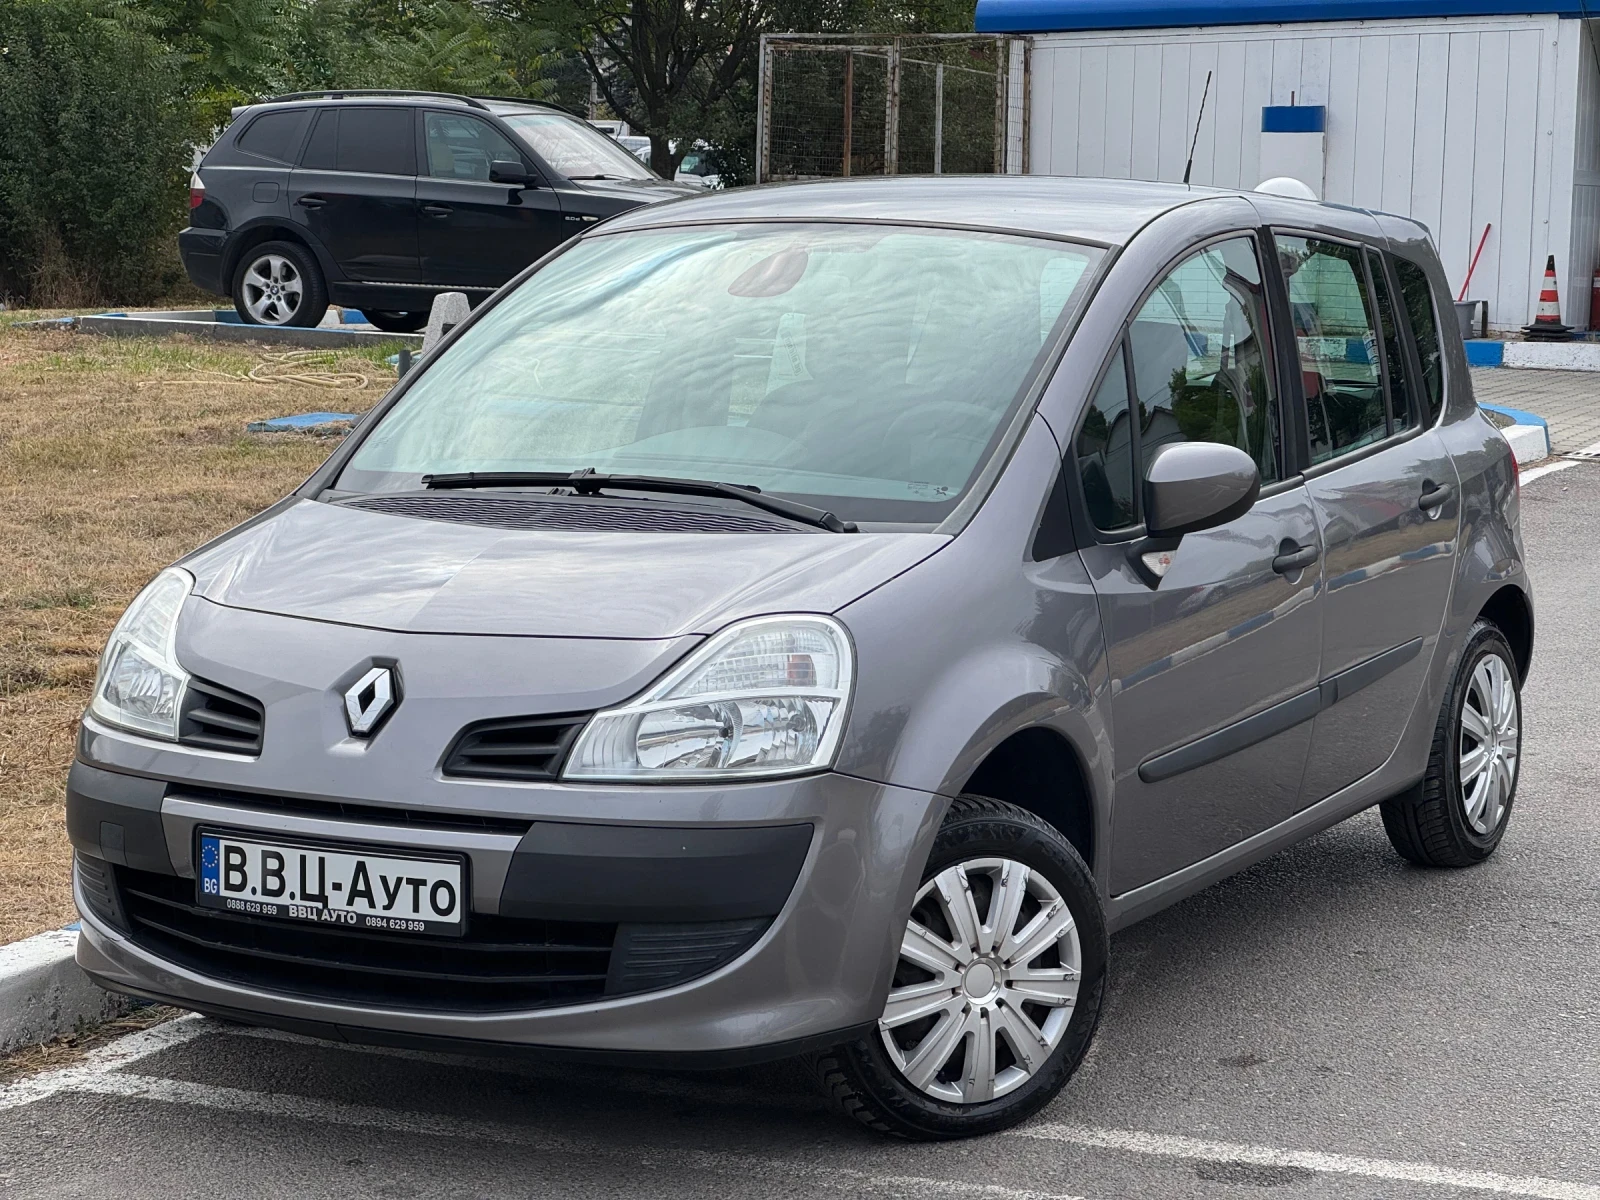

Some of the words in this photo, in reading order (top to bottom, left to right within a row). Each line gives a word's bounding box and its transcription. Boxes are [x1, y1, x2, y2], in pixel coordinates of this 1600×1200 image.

[204, 877, 218, 894] BG
[226, 899, 245, 910] 0888
[246, 901, 261, 913] 629
[262, 904, 277, 915] 959
[288, 905, 318, 921] ВВЦ
[321, 909, 357, 924] АУТО
[365, 916, 388, 928] 0894
[389, 919, 407, 930] 629
[407, 921, 425, 932] 959
